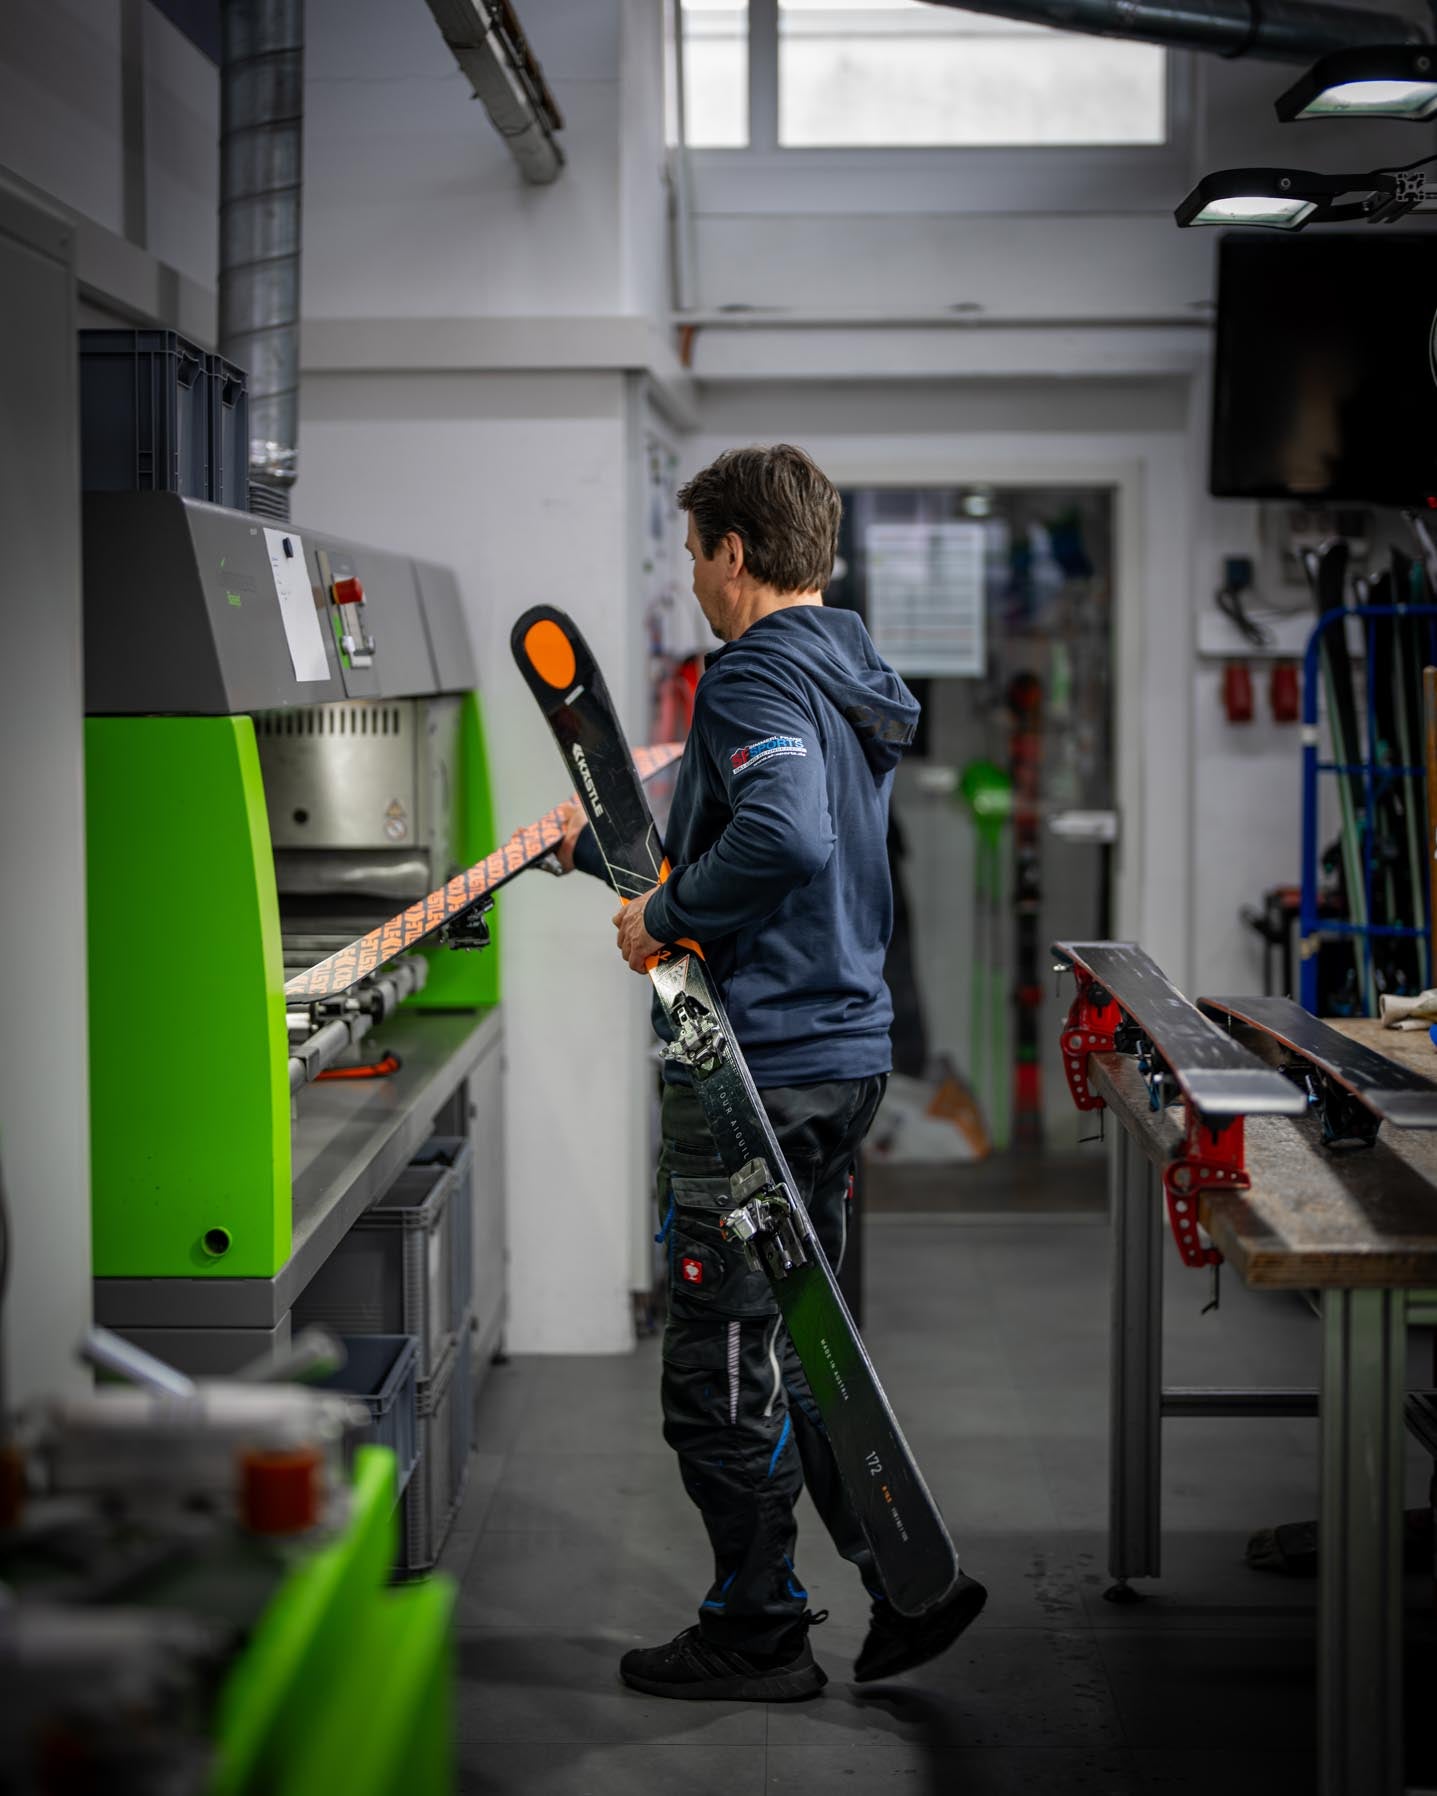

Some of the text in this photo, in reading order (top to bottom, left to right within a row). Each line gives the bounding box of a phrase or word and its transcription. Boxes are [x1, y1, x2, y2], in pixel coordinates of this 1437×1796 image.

[750, 738, 804, 757] SPORTS
[717, 1084, 750, 1160] TOUR AIGUIL
[865, 1450, 882, 1476] 172
